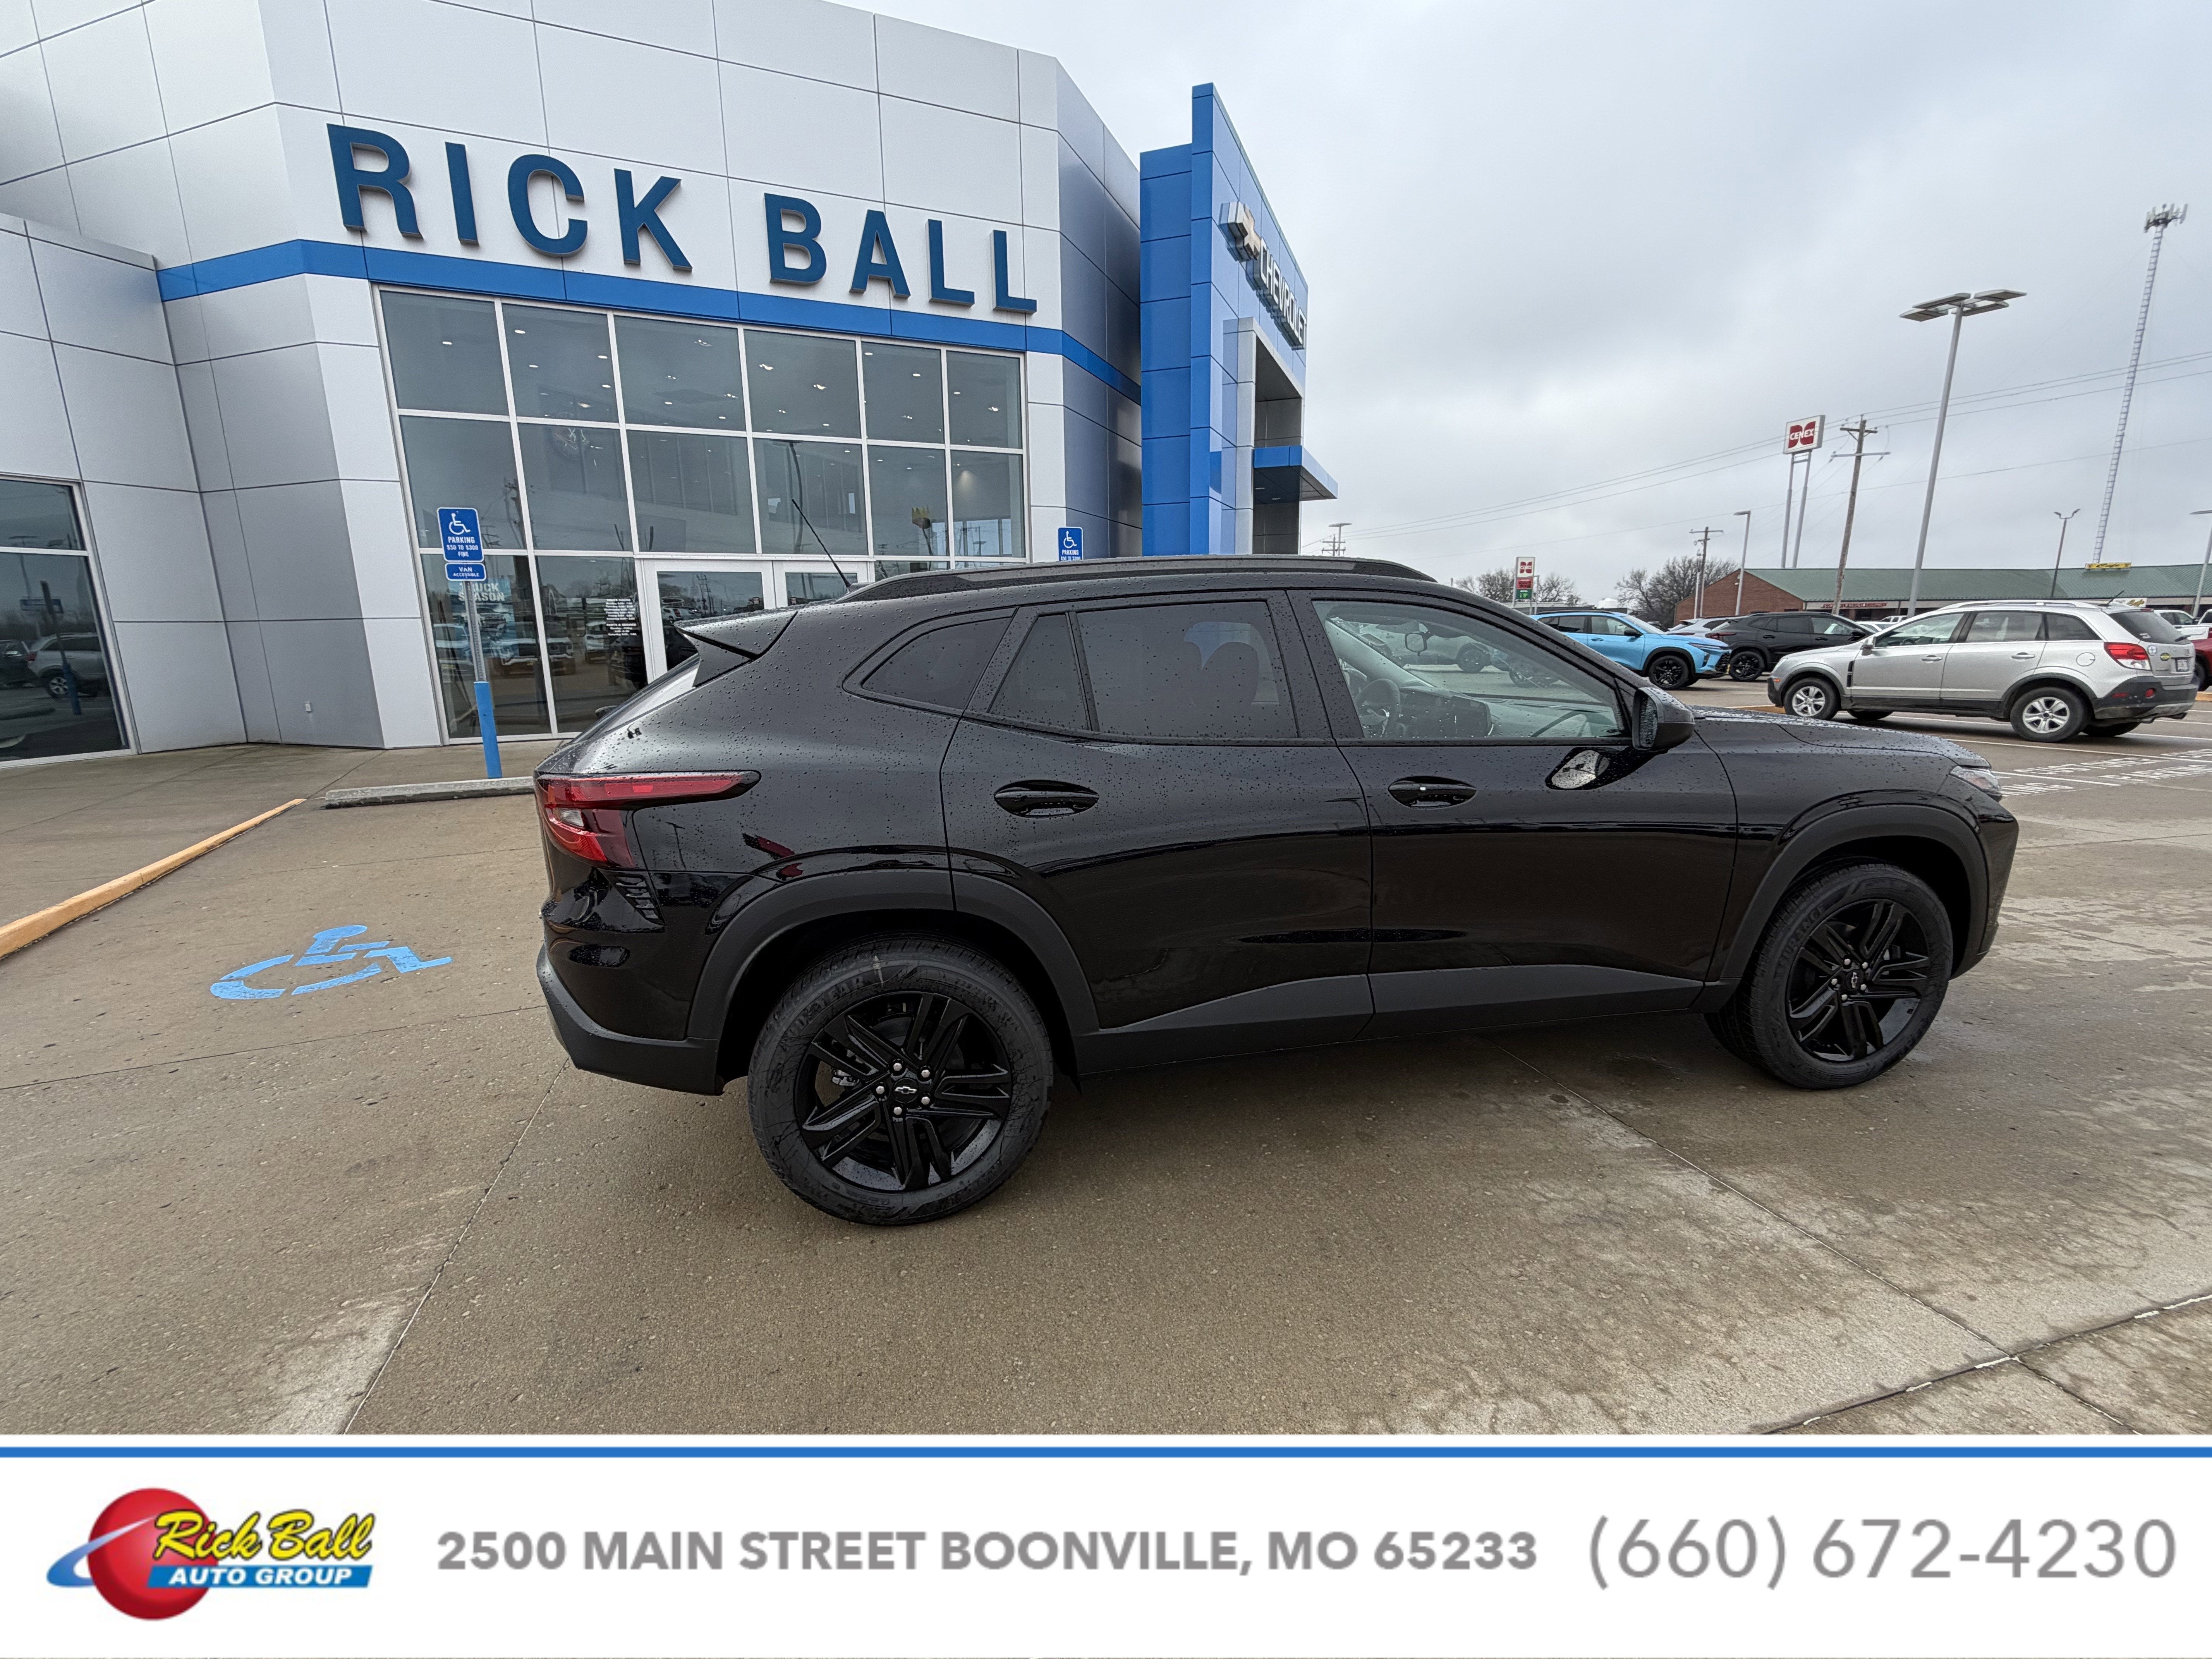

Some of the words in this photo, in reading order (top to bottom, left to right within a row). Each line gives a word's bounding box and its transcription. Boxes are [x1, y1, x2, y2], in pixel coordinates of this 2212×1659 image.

[327, 124, 693, 270] RICK
[764, 193, 1037, 320] BALL
[1260, 237, 1307, 349] CHEVROLET
[1790, 428, 1815, 440] CENEX
[459, 592, 505, 601] SASON
